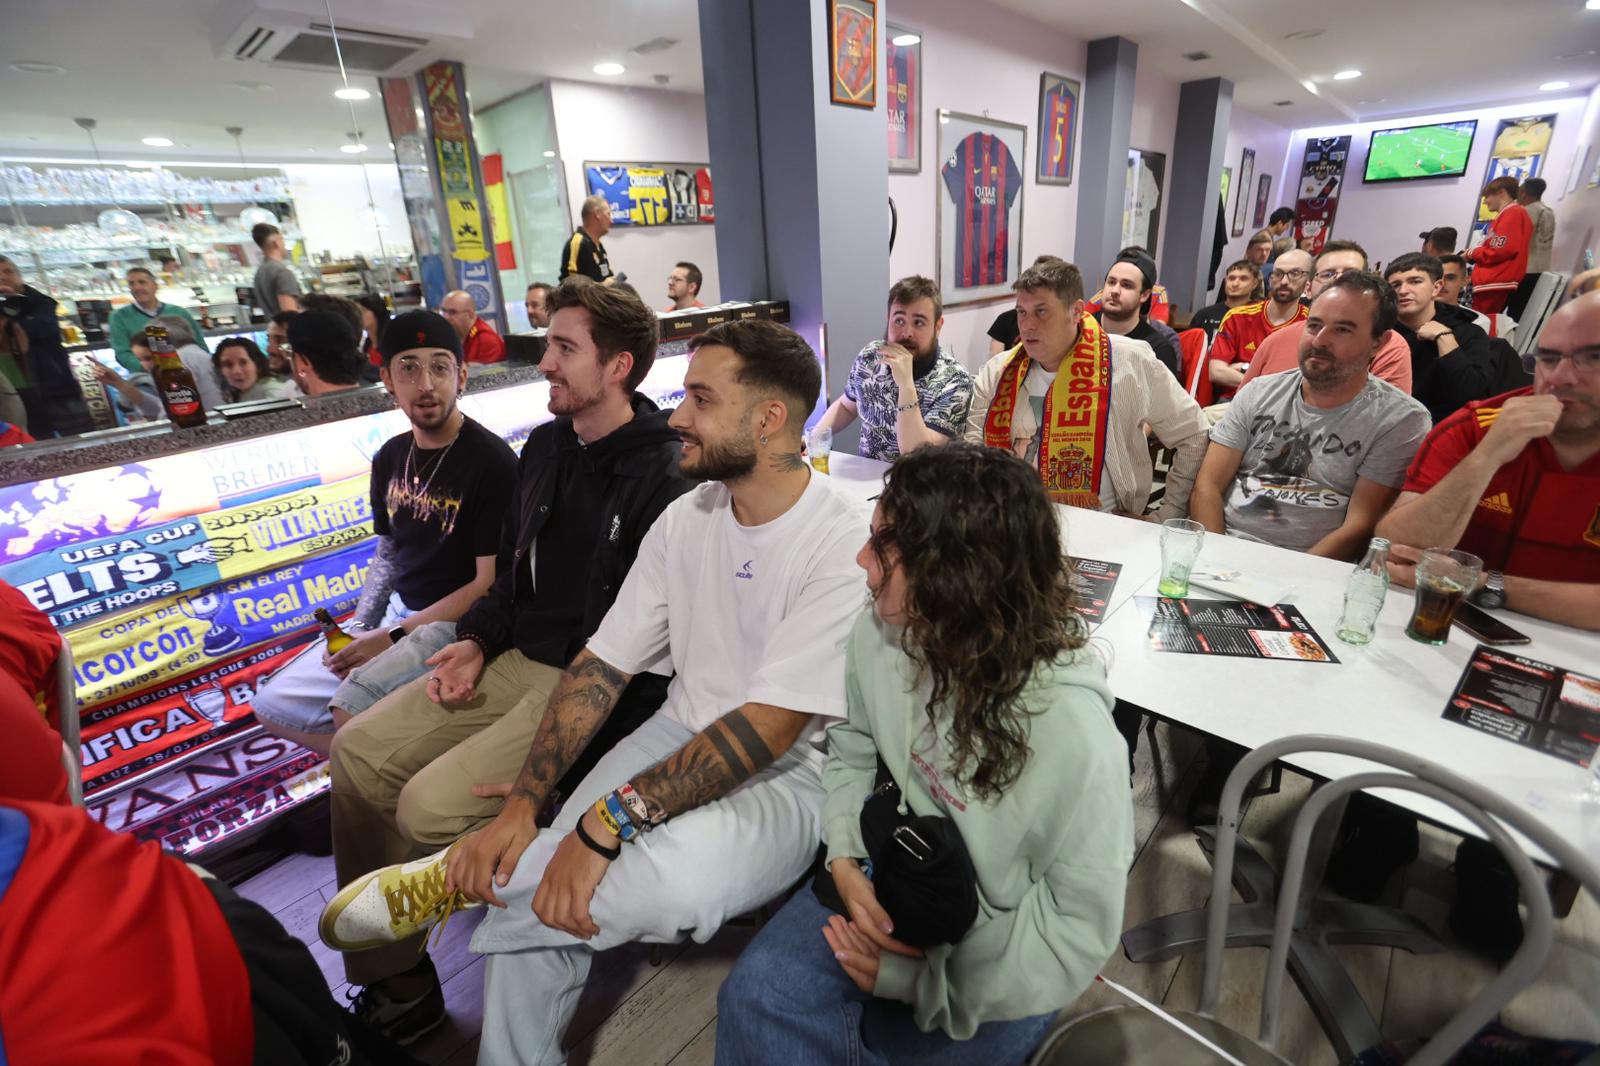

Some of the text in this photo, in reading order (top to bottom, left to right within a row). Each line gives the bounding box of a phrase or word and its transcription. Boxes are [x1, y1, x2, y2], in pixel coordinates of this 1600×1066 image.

[1053, 116, 1064, 163] 5
[975, 186, 996, 199] QATAR
[212, 455, 319, 495] BREMEN
[205, 494, 320, 531] 2003-2004
[250, 495, 372, 552] VILLARRE
[61, 522, 200, 564] UEFA CUP
[16, 552, 163, 611] ELTS
[60, 602, 104, 622] THE
[105, 581, 178, 610] HOOPS
[100, 616, 151, 639] COPA
[155, 605, 180, 621] DE
[257, 575, 274, 587] EL
[276, 565, 304, 582] REY
[74, 558, 374, 687] lcorcón Real Madr
[271, 612, 316, 633] MADRI
[92, 645, 284, 721] CHAMPIONS LEAGUE 2006
[165, 784, 295, 852] FORZA
